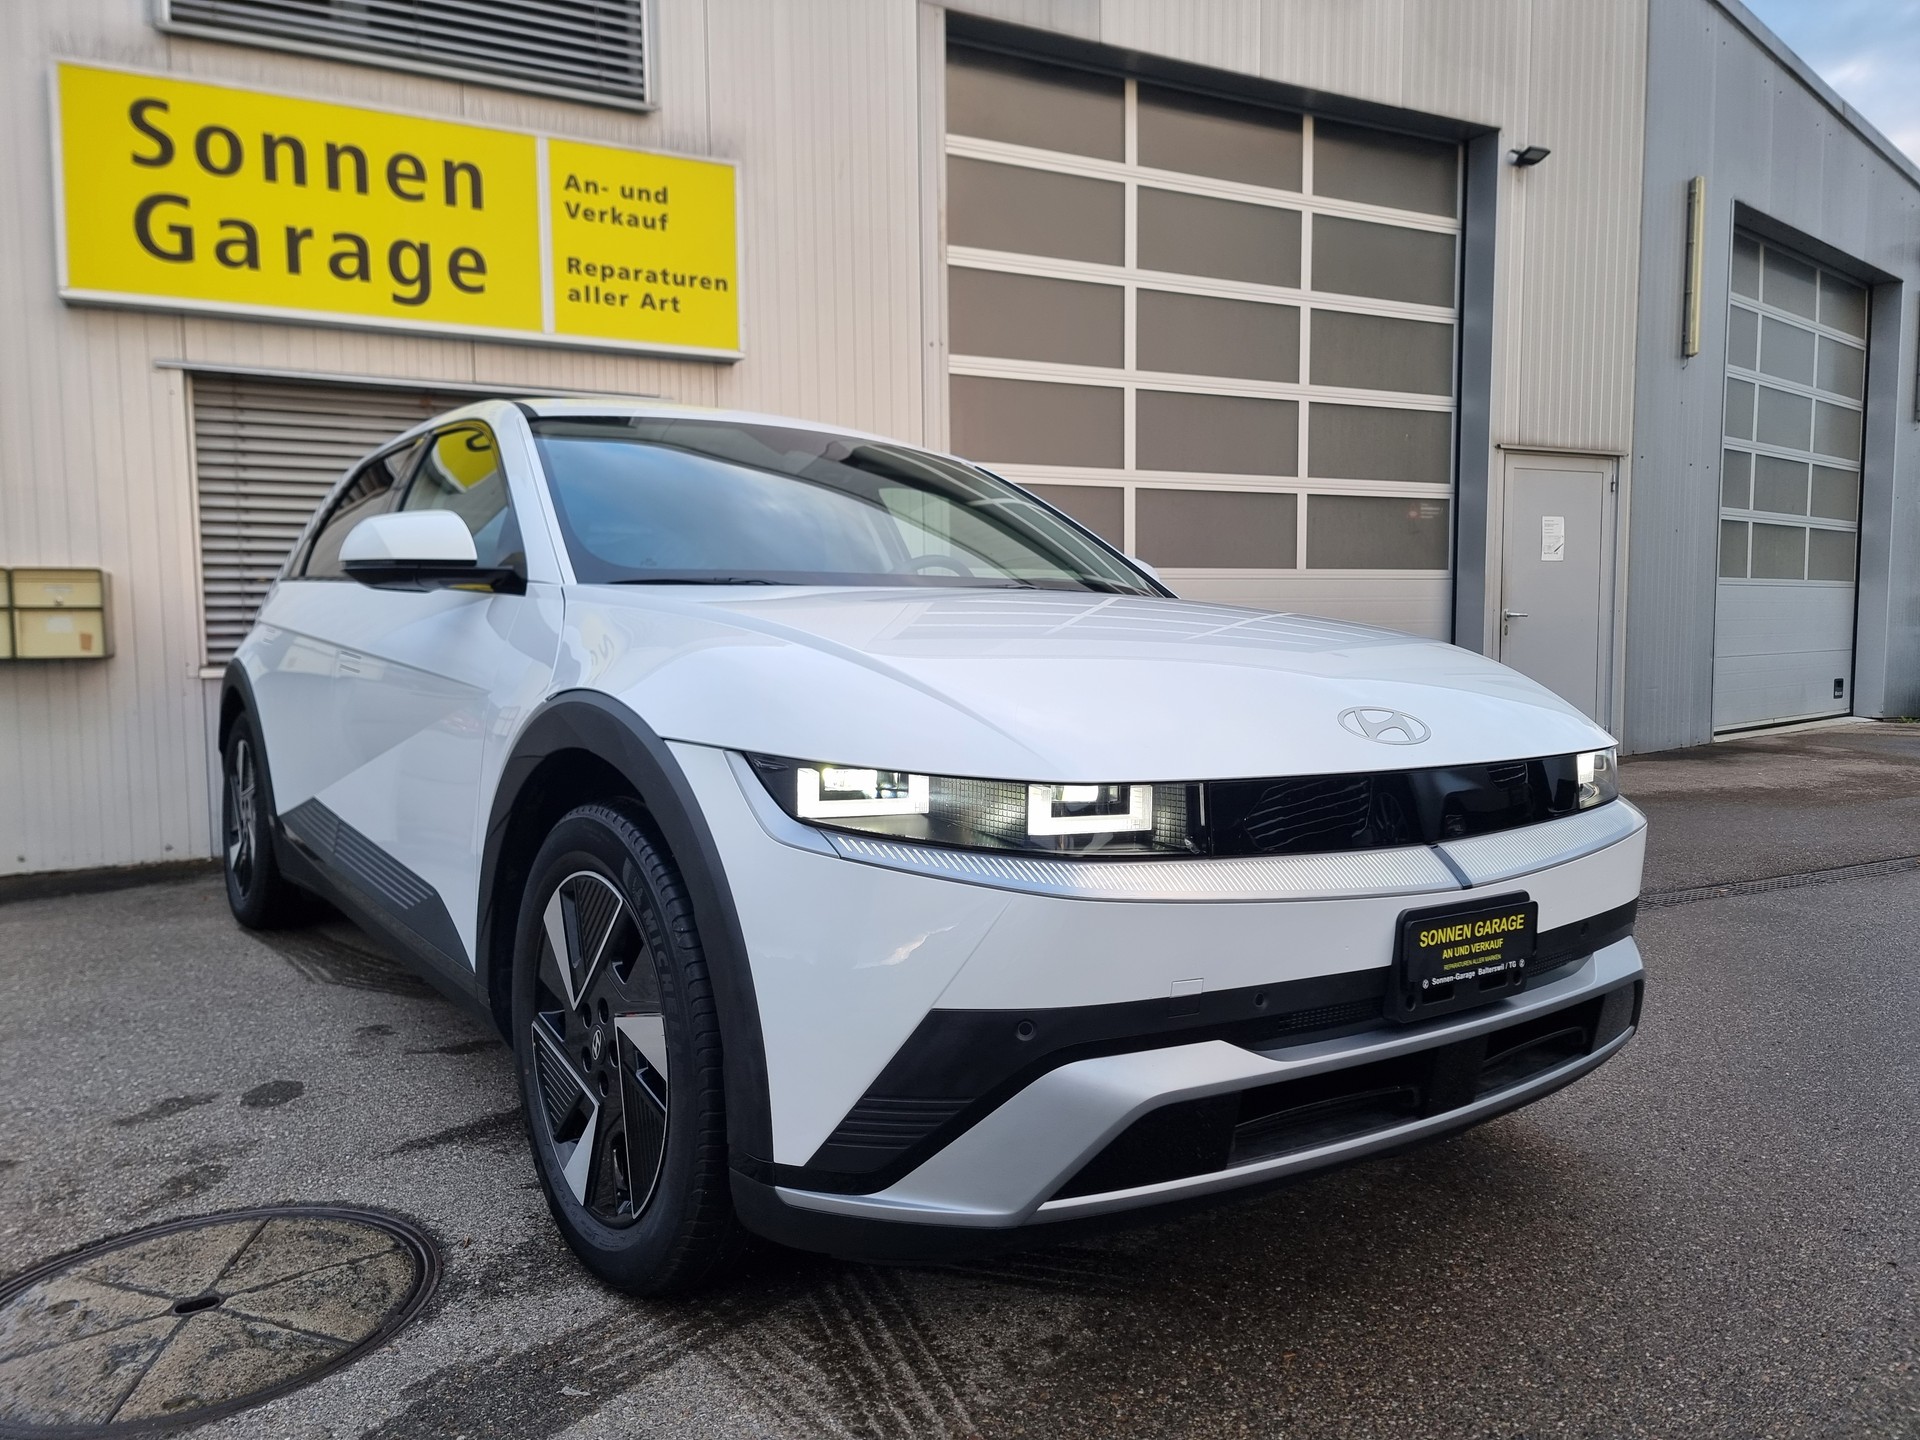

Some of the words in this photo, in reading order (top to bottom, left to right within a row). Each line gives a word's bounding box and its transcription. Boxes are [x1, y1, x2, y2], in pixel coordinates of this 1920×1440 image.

[127, 96, 487, 211] Sonnen
[564, 173, 609, 195] An-
[620, 185, 669, 206] und
[564, 200, 670, 232] Verkauf
[132, 191, 488, 307] Garage
[567, 256, 729, 293] Reparaturen
[567, 284, 630, 308] aller
[640, 293, 682, 314] Art
[1419, 923, 1472, 948] SONNEN
[1474, 914, 1525, 937] GARAGE
[1442, 948, 1453, 960] AN
[1454, 944, 1470, 957] UND
[1471, 938, 1504, 954] VERKAUF
[1473, 957, 1484, 965] ALLER
[1431, 971, 1475, 985] Sonnen-Garage
[1508, 960, 1517, 969] TG
